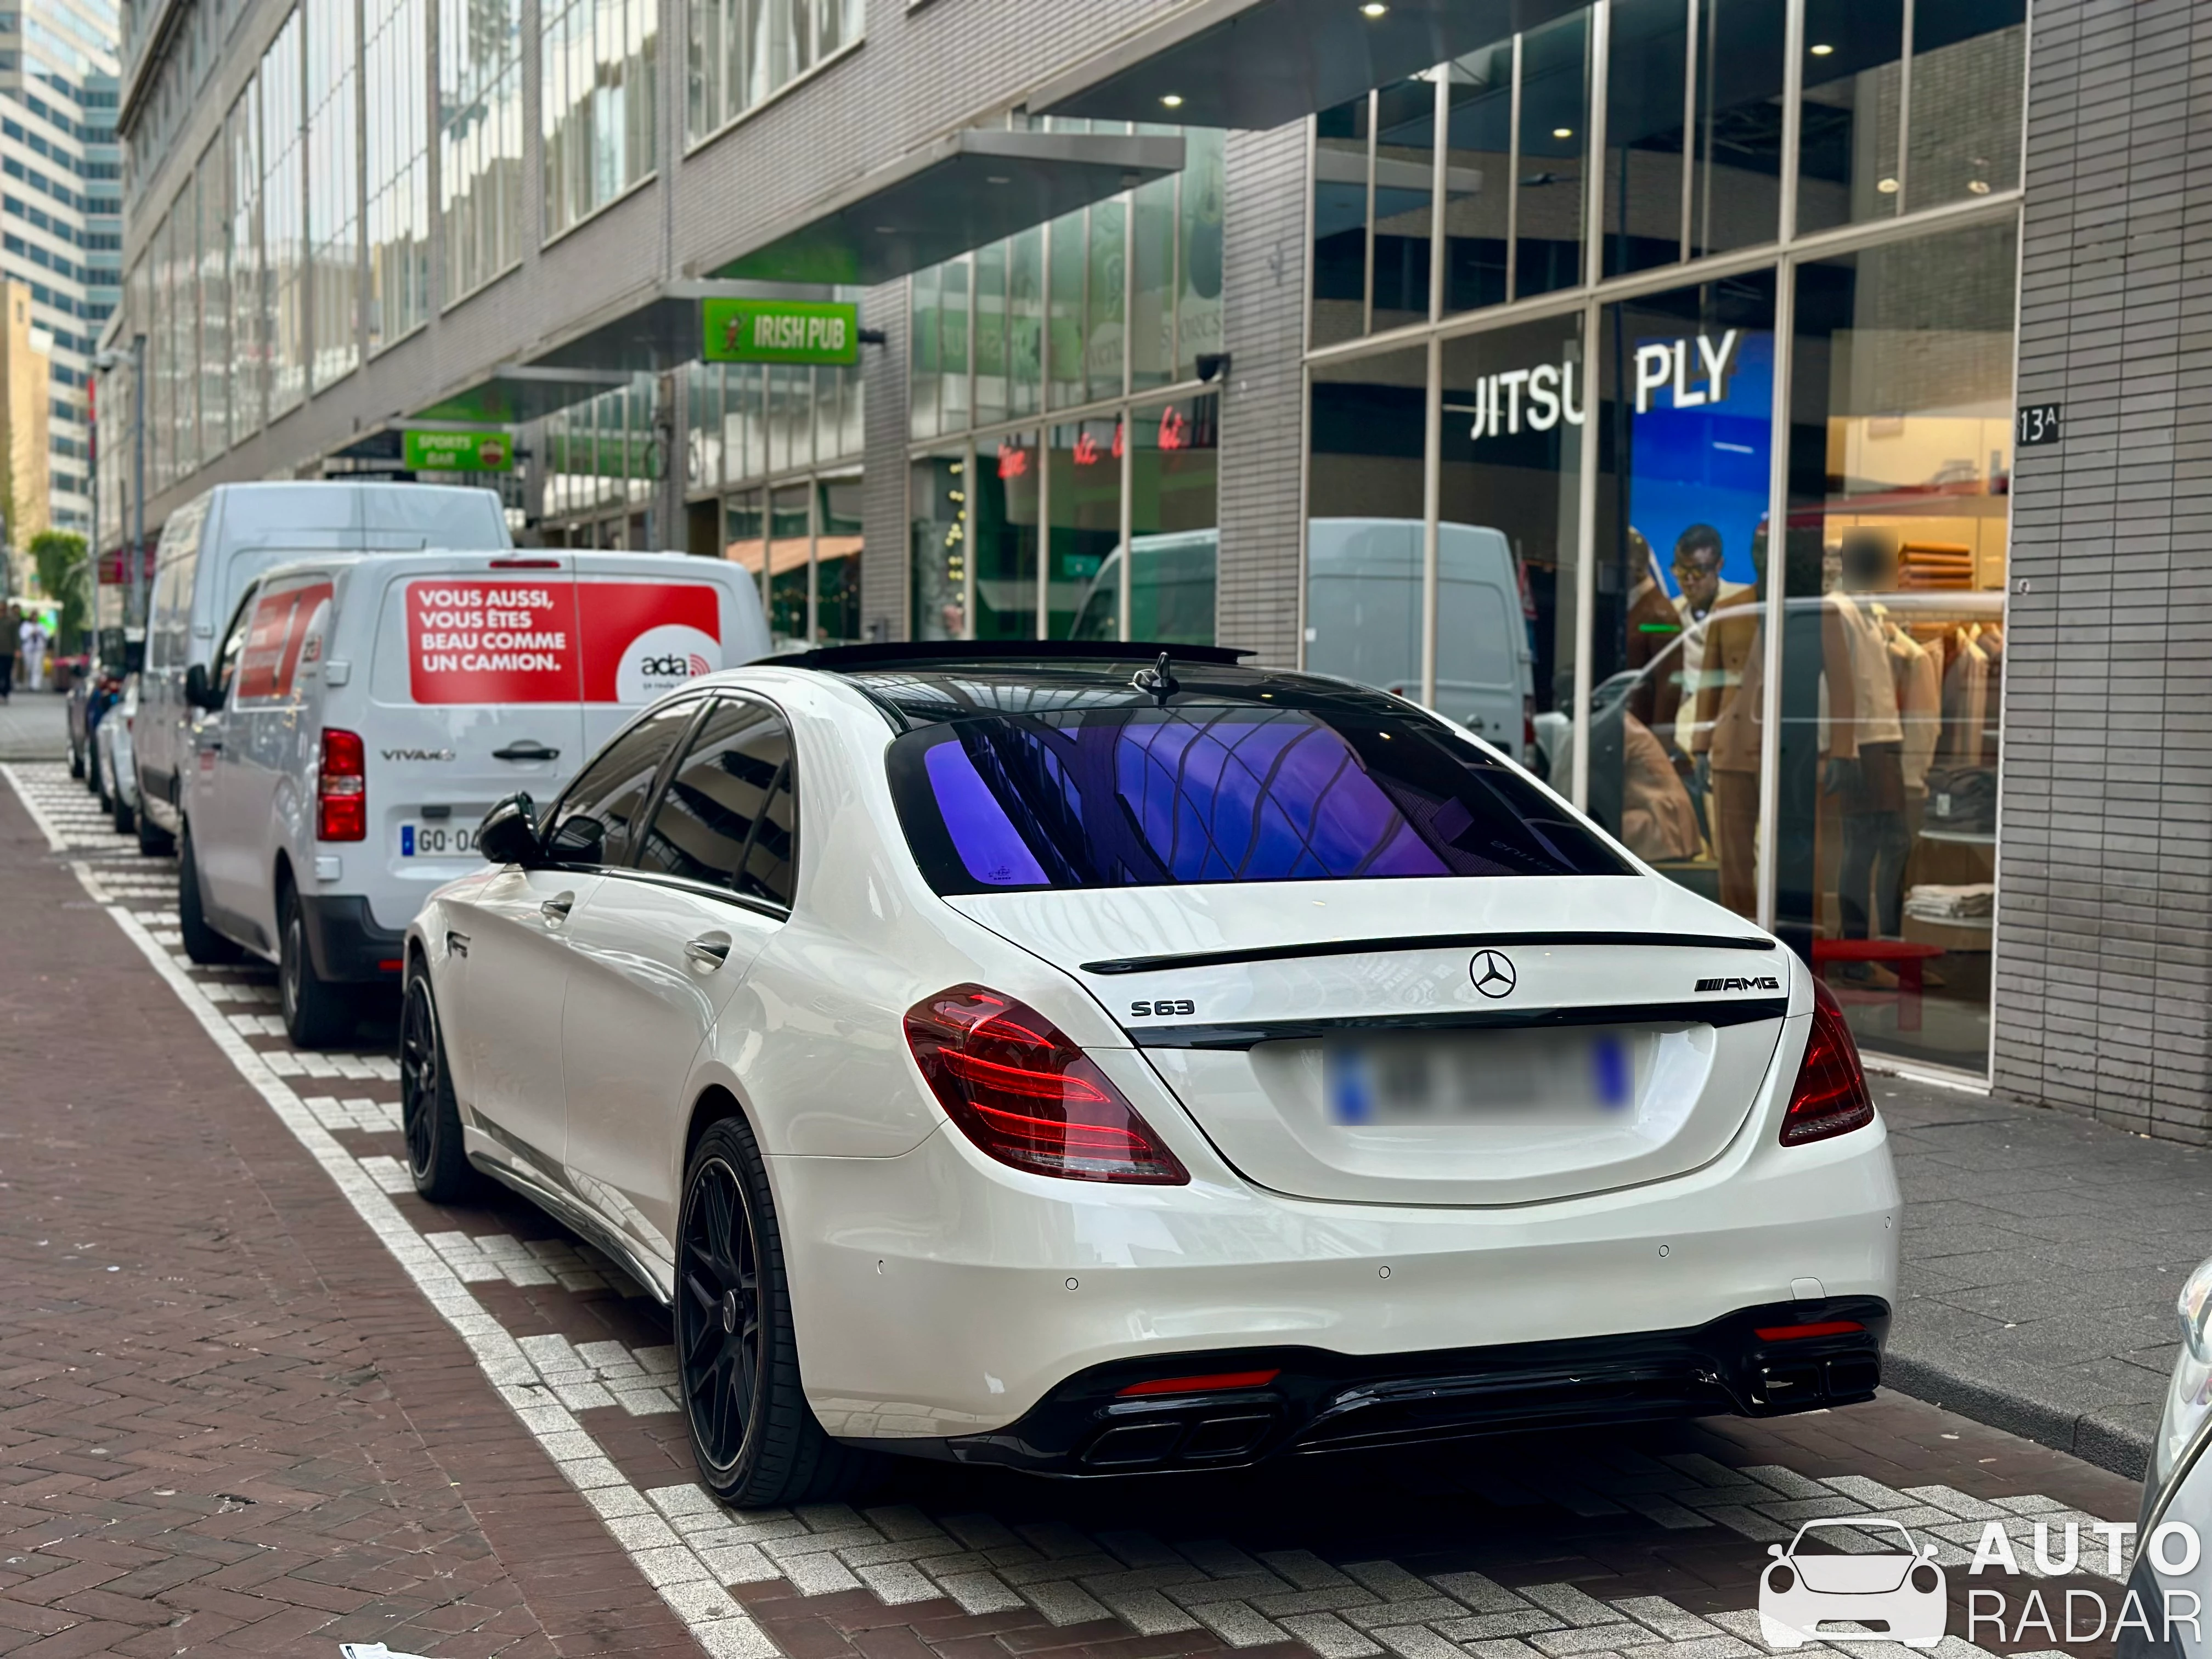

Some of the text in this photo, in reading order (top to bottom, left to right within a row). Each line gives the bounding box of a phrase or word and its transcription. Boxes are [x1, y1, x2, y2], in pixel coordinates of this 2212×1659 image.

[753, 314, 845, 350] IRISH PUB
[2021, 407, 2056, 442] 13A
[418, 434, 471, 450] SPORTS
[418, 590, 554, 610] VOUS AUSSI,
[419, 608, 533, 629] VOUS ÊTES
[421, 631, 567, 650] BEAU COMME
[422, 653, 561, 672] UN CAMION.
[641, 653, 687, 676] ada
[1723, 977, 1780, 991] AMG
